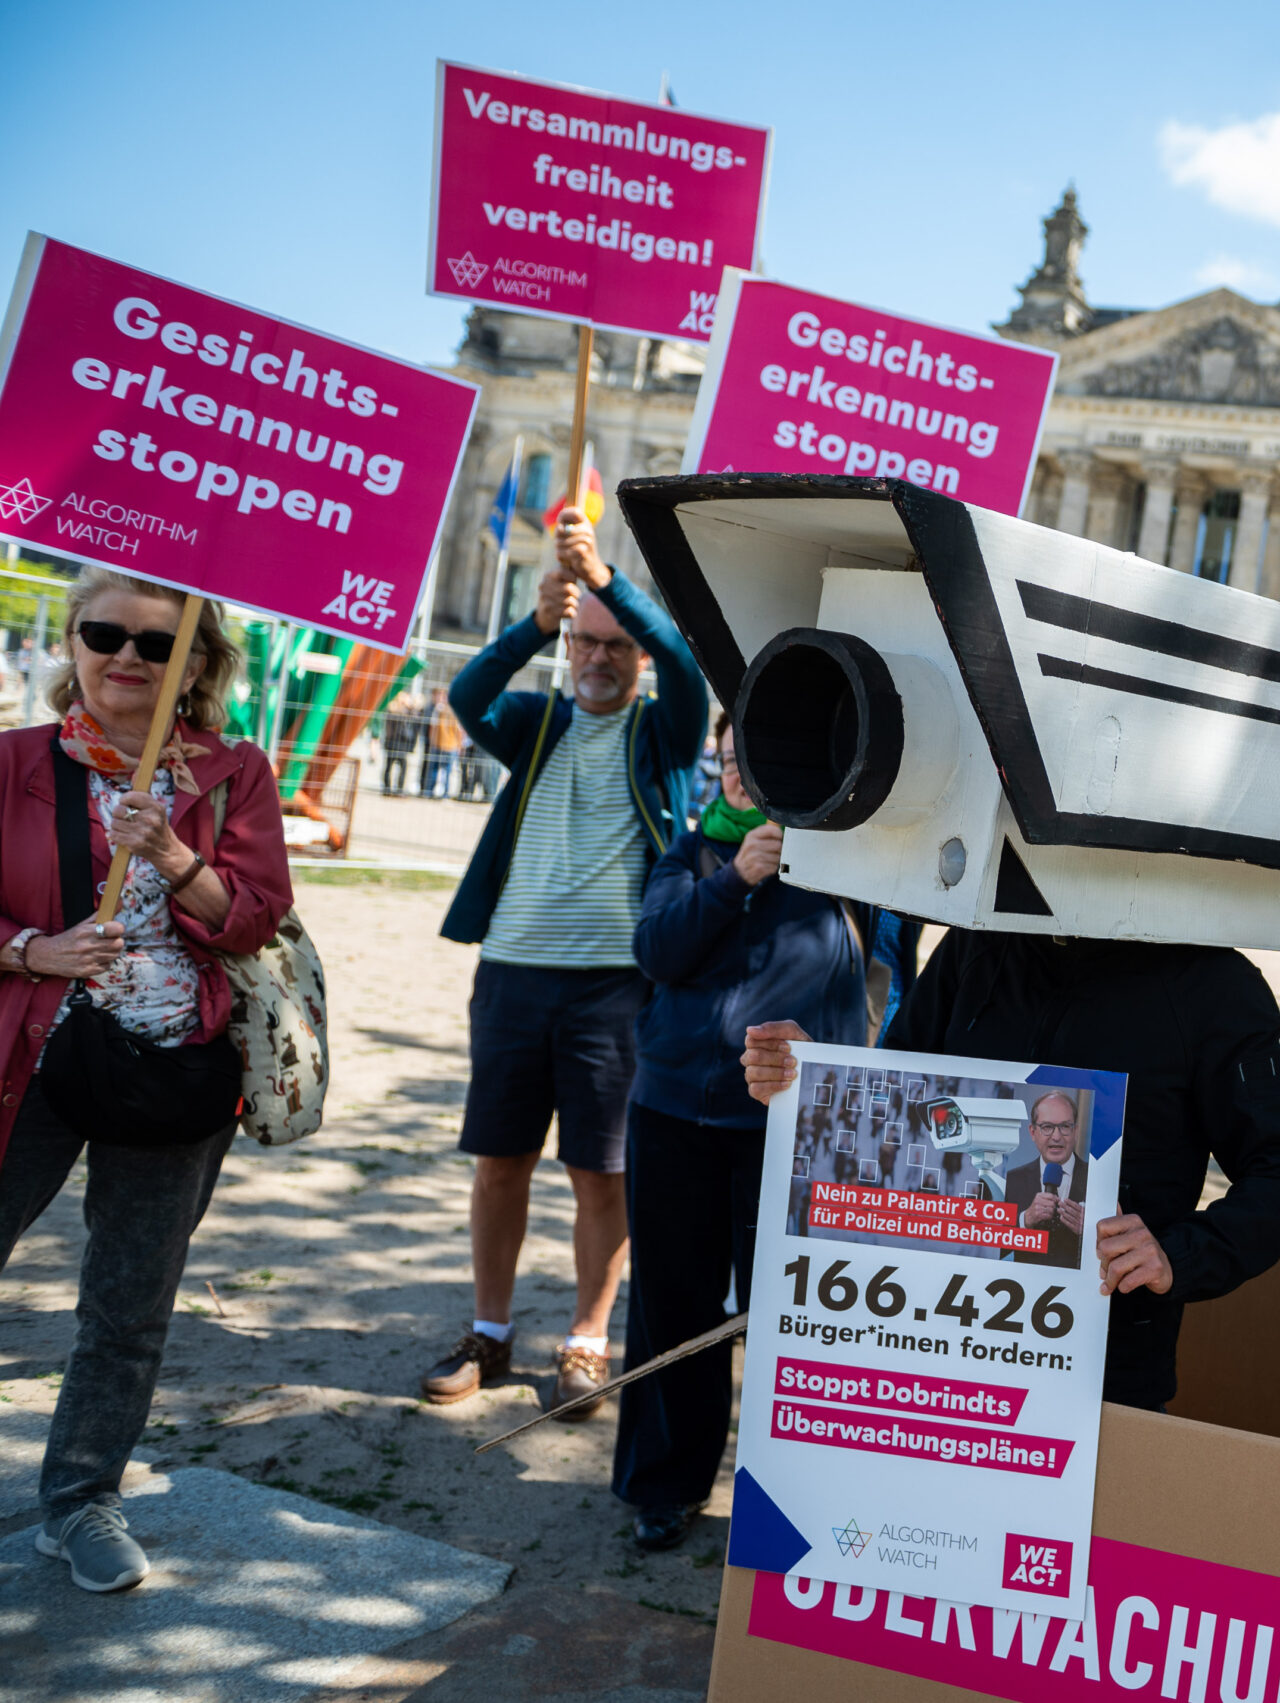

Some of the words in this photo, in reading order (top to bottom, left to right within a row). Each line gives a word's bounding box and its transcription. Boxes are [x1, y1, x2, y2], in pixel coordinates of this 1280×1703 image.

[463, 88, 746, 172] Versammlungs-
[533, 154, 673, 209] freiheit
[483, 203, 713, 266] verteidigen!
[492, 277, 550, 301] WATCH
[493, 257, 587, 288] ALGORITHM
[678, 311, 715, 334] AC
[113, 297, 398, 418] Gesichts-
[788, 312, 993, 392] Gesichts-
[72, 356, 404, 495] erkennung
[760, 364, 999, 458] erkennung
[93, 429, 352, 534] stoppen
[773, 420, 959, 494] stoppen
[57, 516, 140, 555] WATCH
[61, 492, 198, 546] ALGORITHM
[341, 569, 395, 606] WE
[813, 1207, 840, 1226] für
[844, 1211, 902, 1234] Polizei
[907, 1218, 942, 1237] und
[947, 1223, 1042, 1249] Behörden!
[816, 1184, 857, 1204] Nein
[861, 1193, 882, 1207] zu
[887, 1190, 960, 1219] Palantir
[964, 1201, 976, 1217] &
[982, 1203, 1010, 1221] Co.
[784, 1254, 1075, 1338] 166.426
[961, 1336, 1073, 1371] fordern:
[780, 1366, 871, 1400] Stoppt
[877, 1379, 1011, 1417] Dobrindts
[776, 1405, 1056, 1469] Überwachungspläne!
[878, 1547, 937, 1570] WATCH
[879, 1523, 978, 1552] ALGORITHM
[1019, 1544, 1058, 1567] WE
